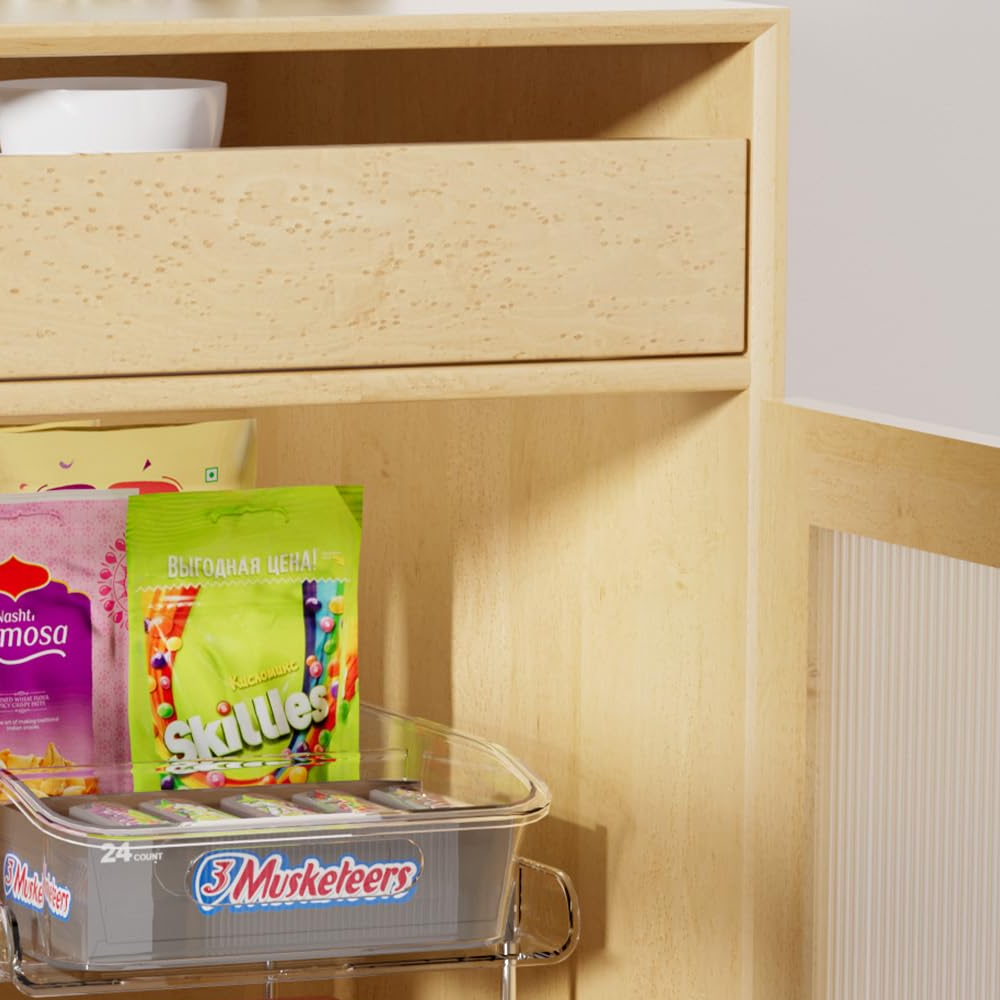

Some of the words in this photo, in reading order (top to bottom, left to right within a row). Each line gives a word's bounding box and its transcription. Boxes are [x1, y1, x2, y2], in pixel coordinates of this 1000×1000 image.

[167, 555, 261, 579] ВЫГОДНАЯ
[266, 548, 318, 576] ЦЕНА!
[100, 842, 134, 864] 24
[133, 852, 163, 862] COUNT
[203, 860, 236, 895] 3
[232, 858, 412, 900] Musketeers
